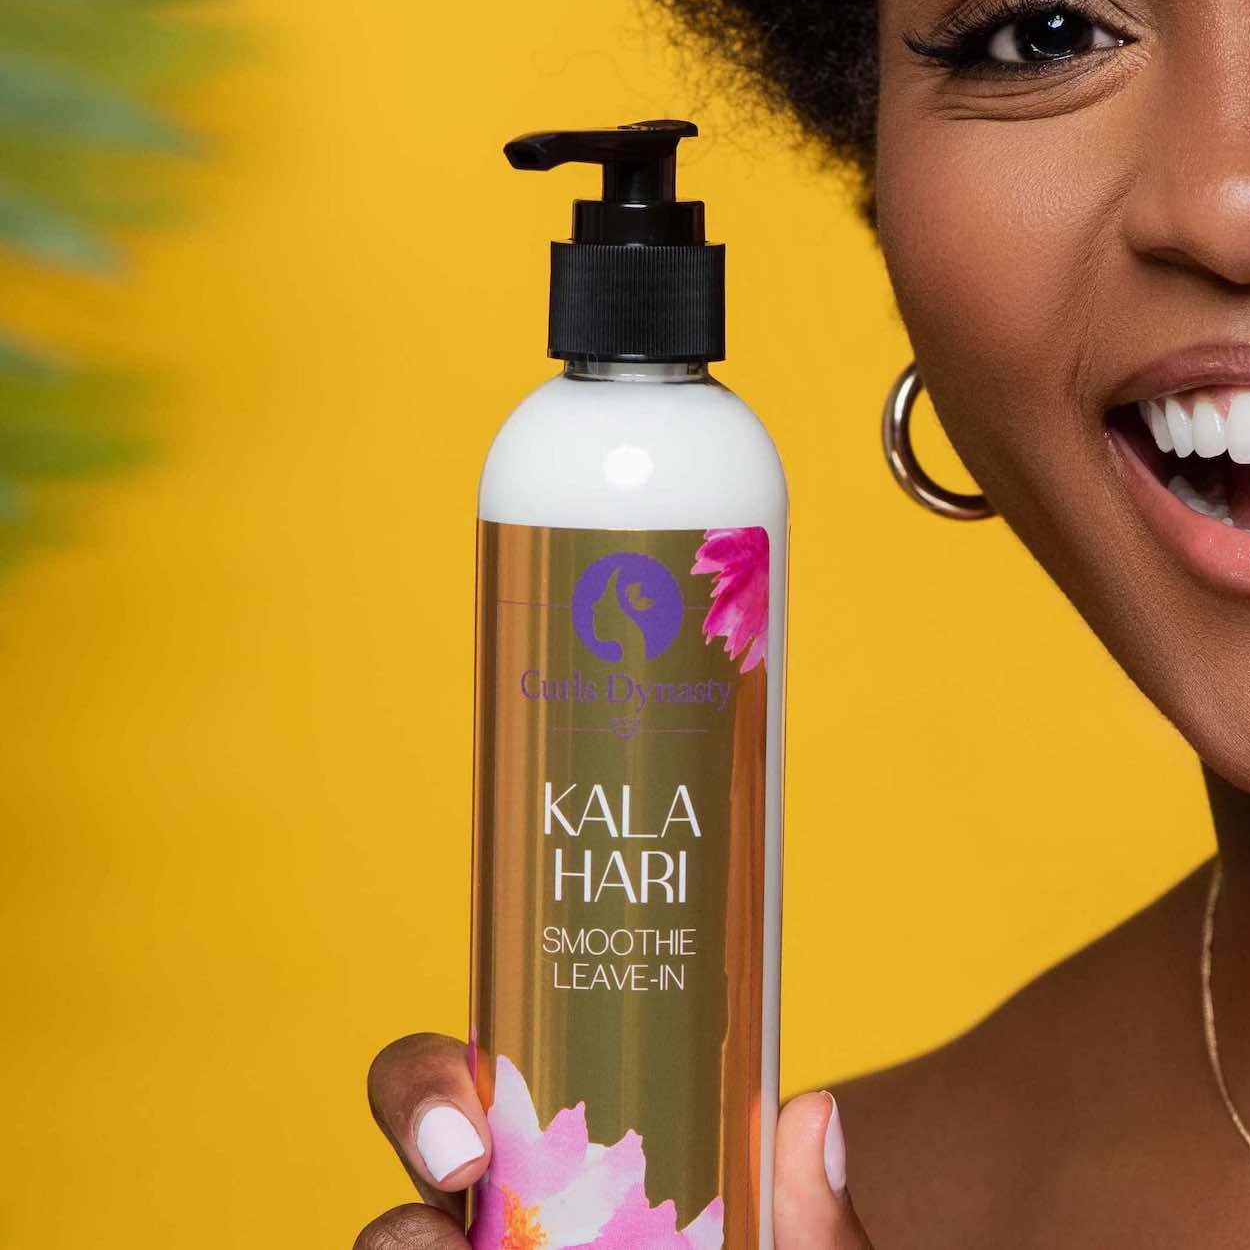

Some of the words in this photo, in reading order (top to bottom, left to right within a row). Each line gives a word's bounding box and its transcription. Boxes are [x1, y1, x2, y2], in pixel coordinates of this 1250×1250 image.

[520, 669, 598, 703] Curls
[606, 672, 731, 713] Dynasty
[543, 781, 702, 838] KALA
[554, 848, 687, 904] HARI
[542, 926, 697, 956] SMOOTHIE
[553, 962, 685, 991] LEAVE-IN
